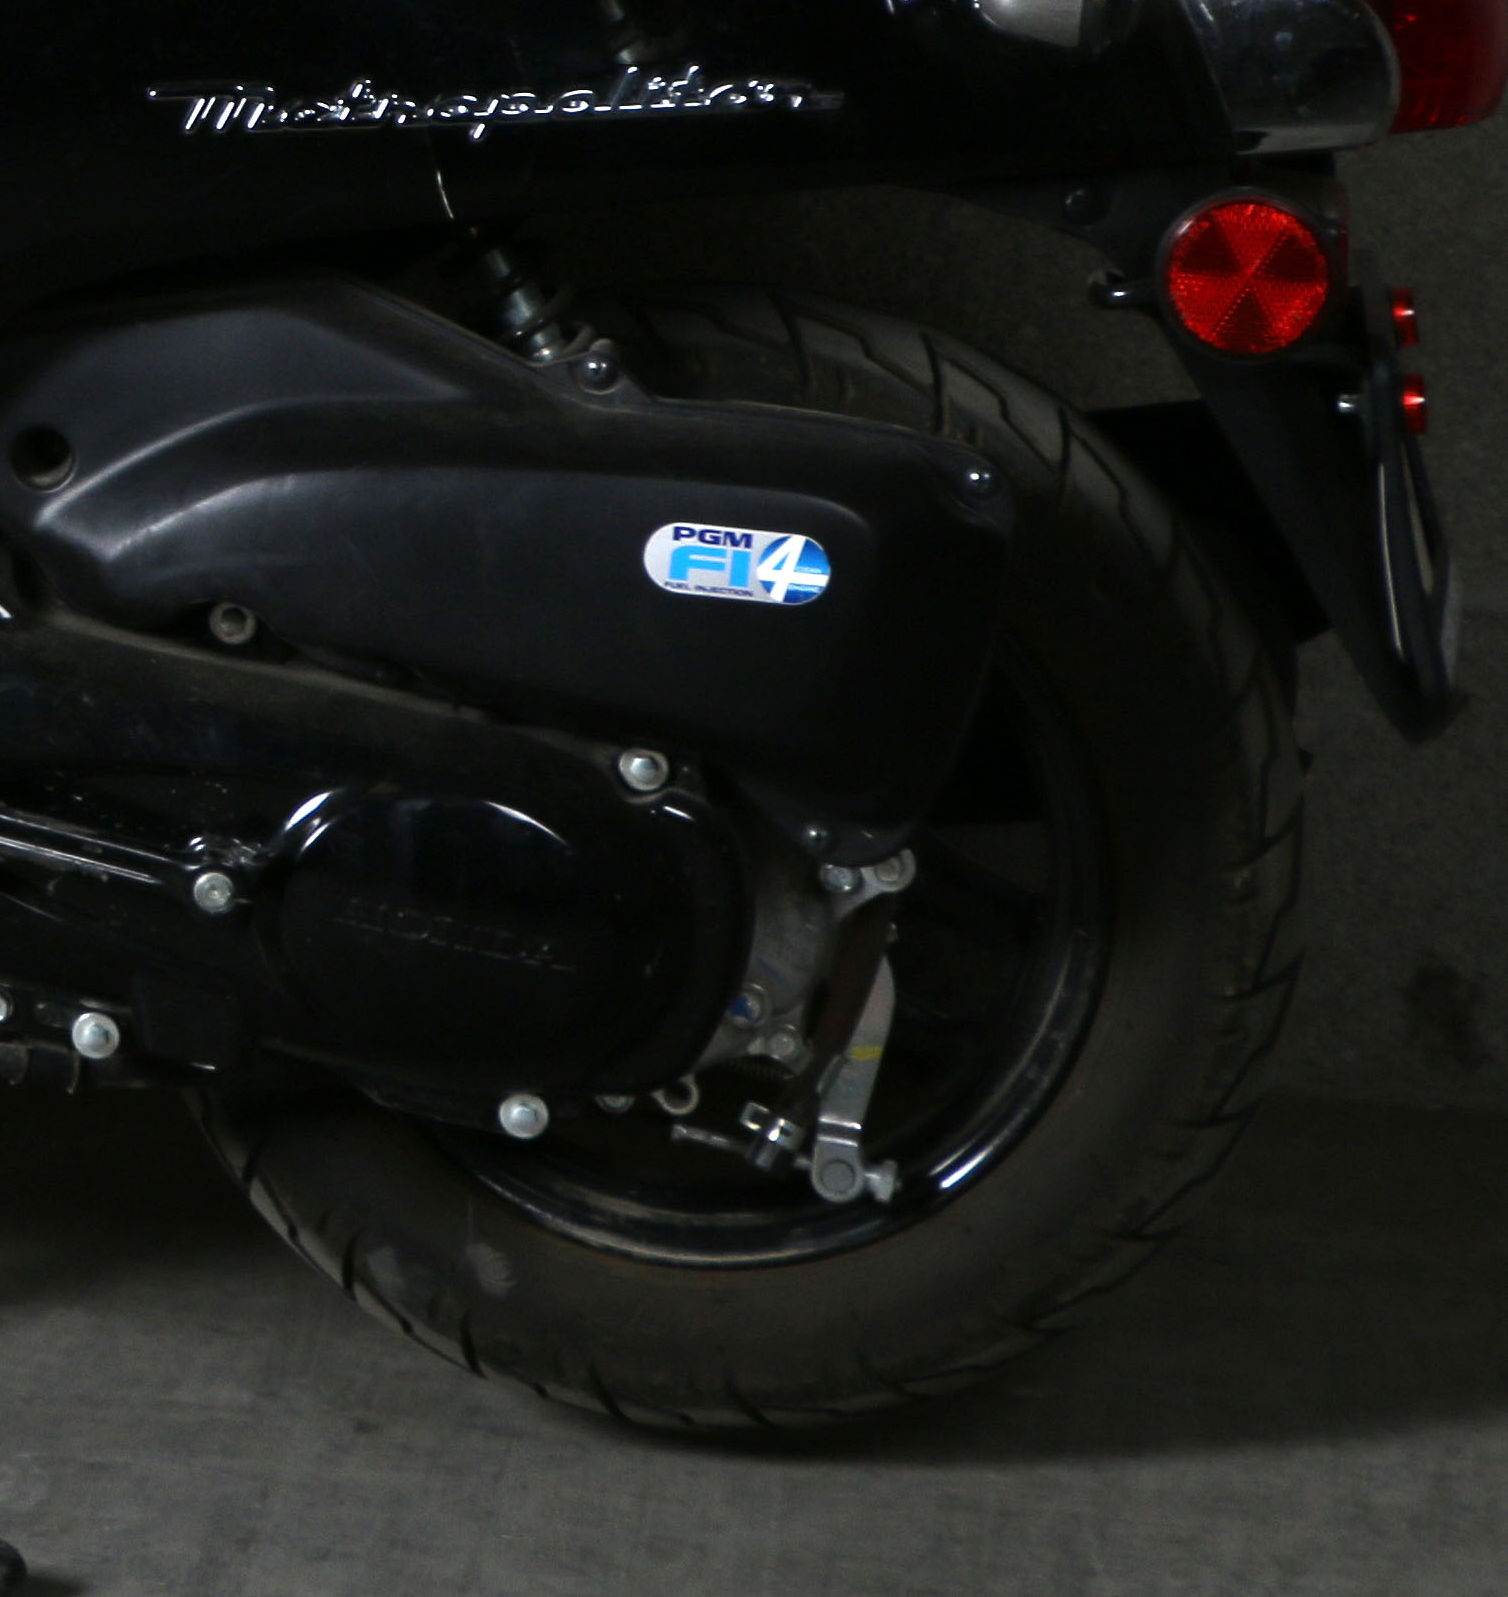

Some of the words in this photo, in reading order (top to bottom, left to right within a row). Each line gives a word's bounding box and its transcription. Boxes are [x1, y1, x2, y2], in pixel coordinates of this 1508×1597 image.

[148, 65, 845, 141] Metropolitan
[674, 527, 753, 548] PGM
[670, 546, 751, 587] FI
[665, 582, 690, 591] FUEL
[695, 585, 754, 597] INJECTION
